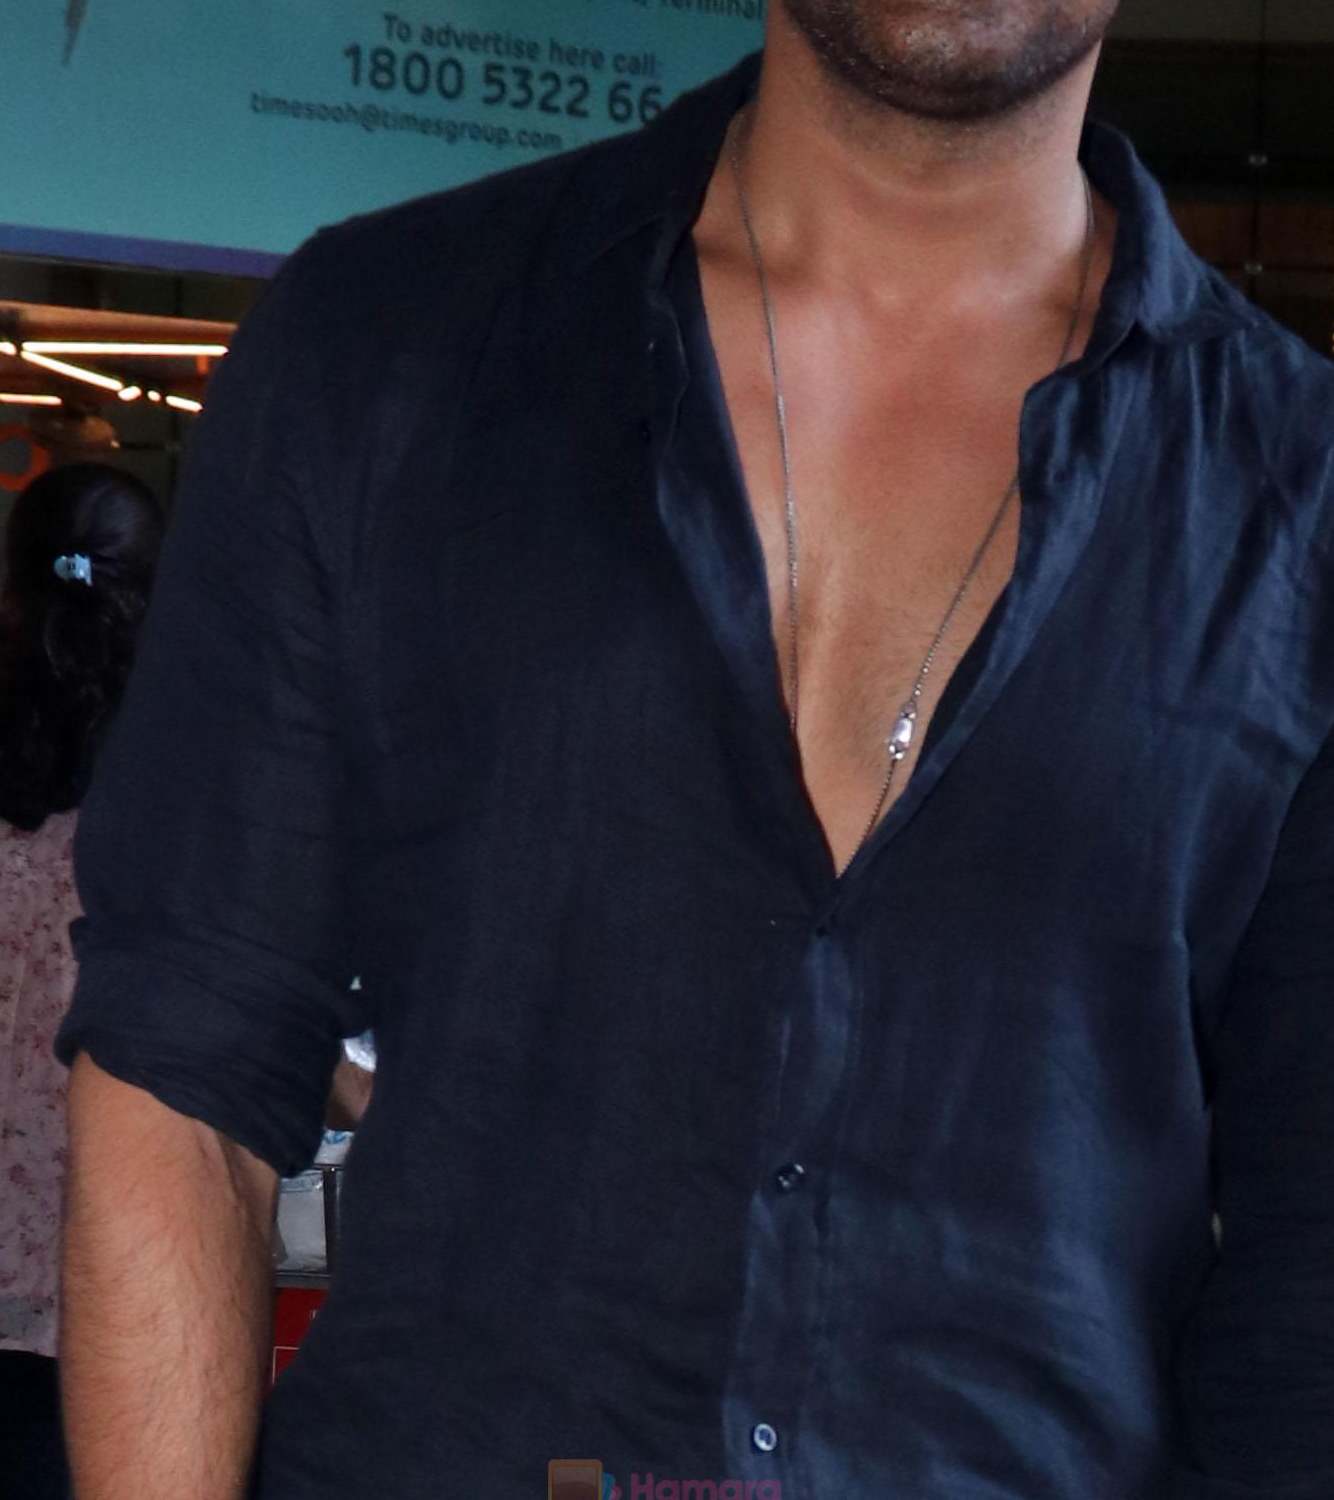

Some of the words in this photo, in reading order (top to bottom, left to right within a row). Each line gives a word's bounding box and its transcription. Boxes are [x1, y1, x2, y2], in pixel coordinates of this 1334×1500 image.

[381, 12, 411, 43] To
[421, 20, 540, 63] advertise
[549, 38, 604, 69] here
[342, 43, 465, 101] 1800
[482, 62, 590, 119] 5322
